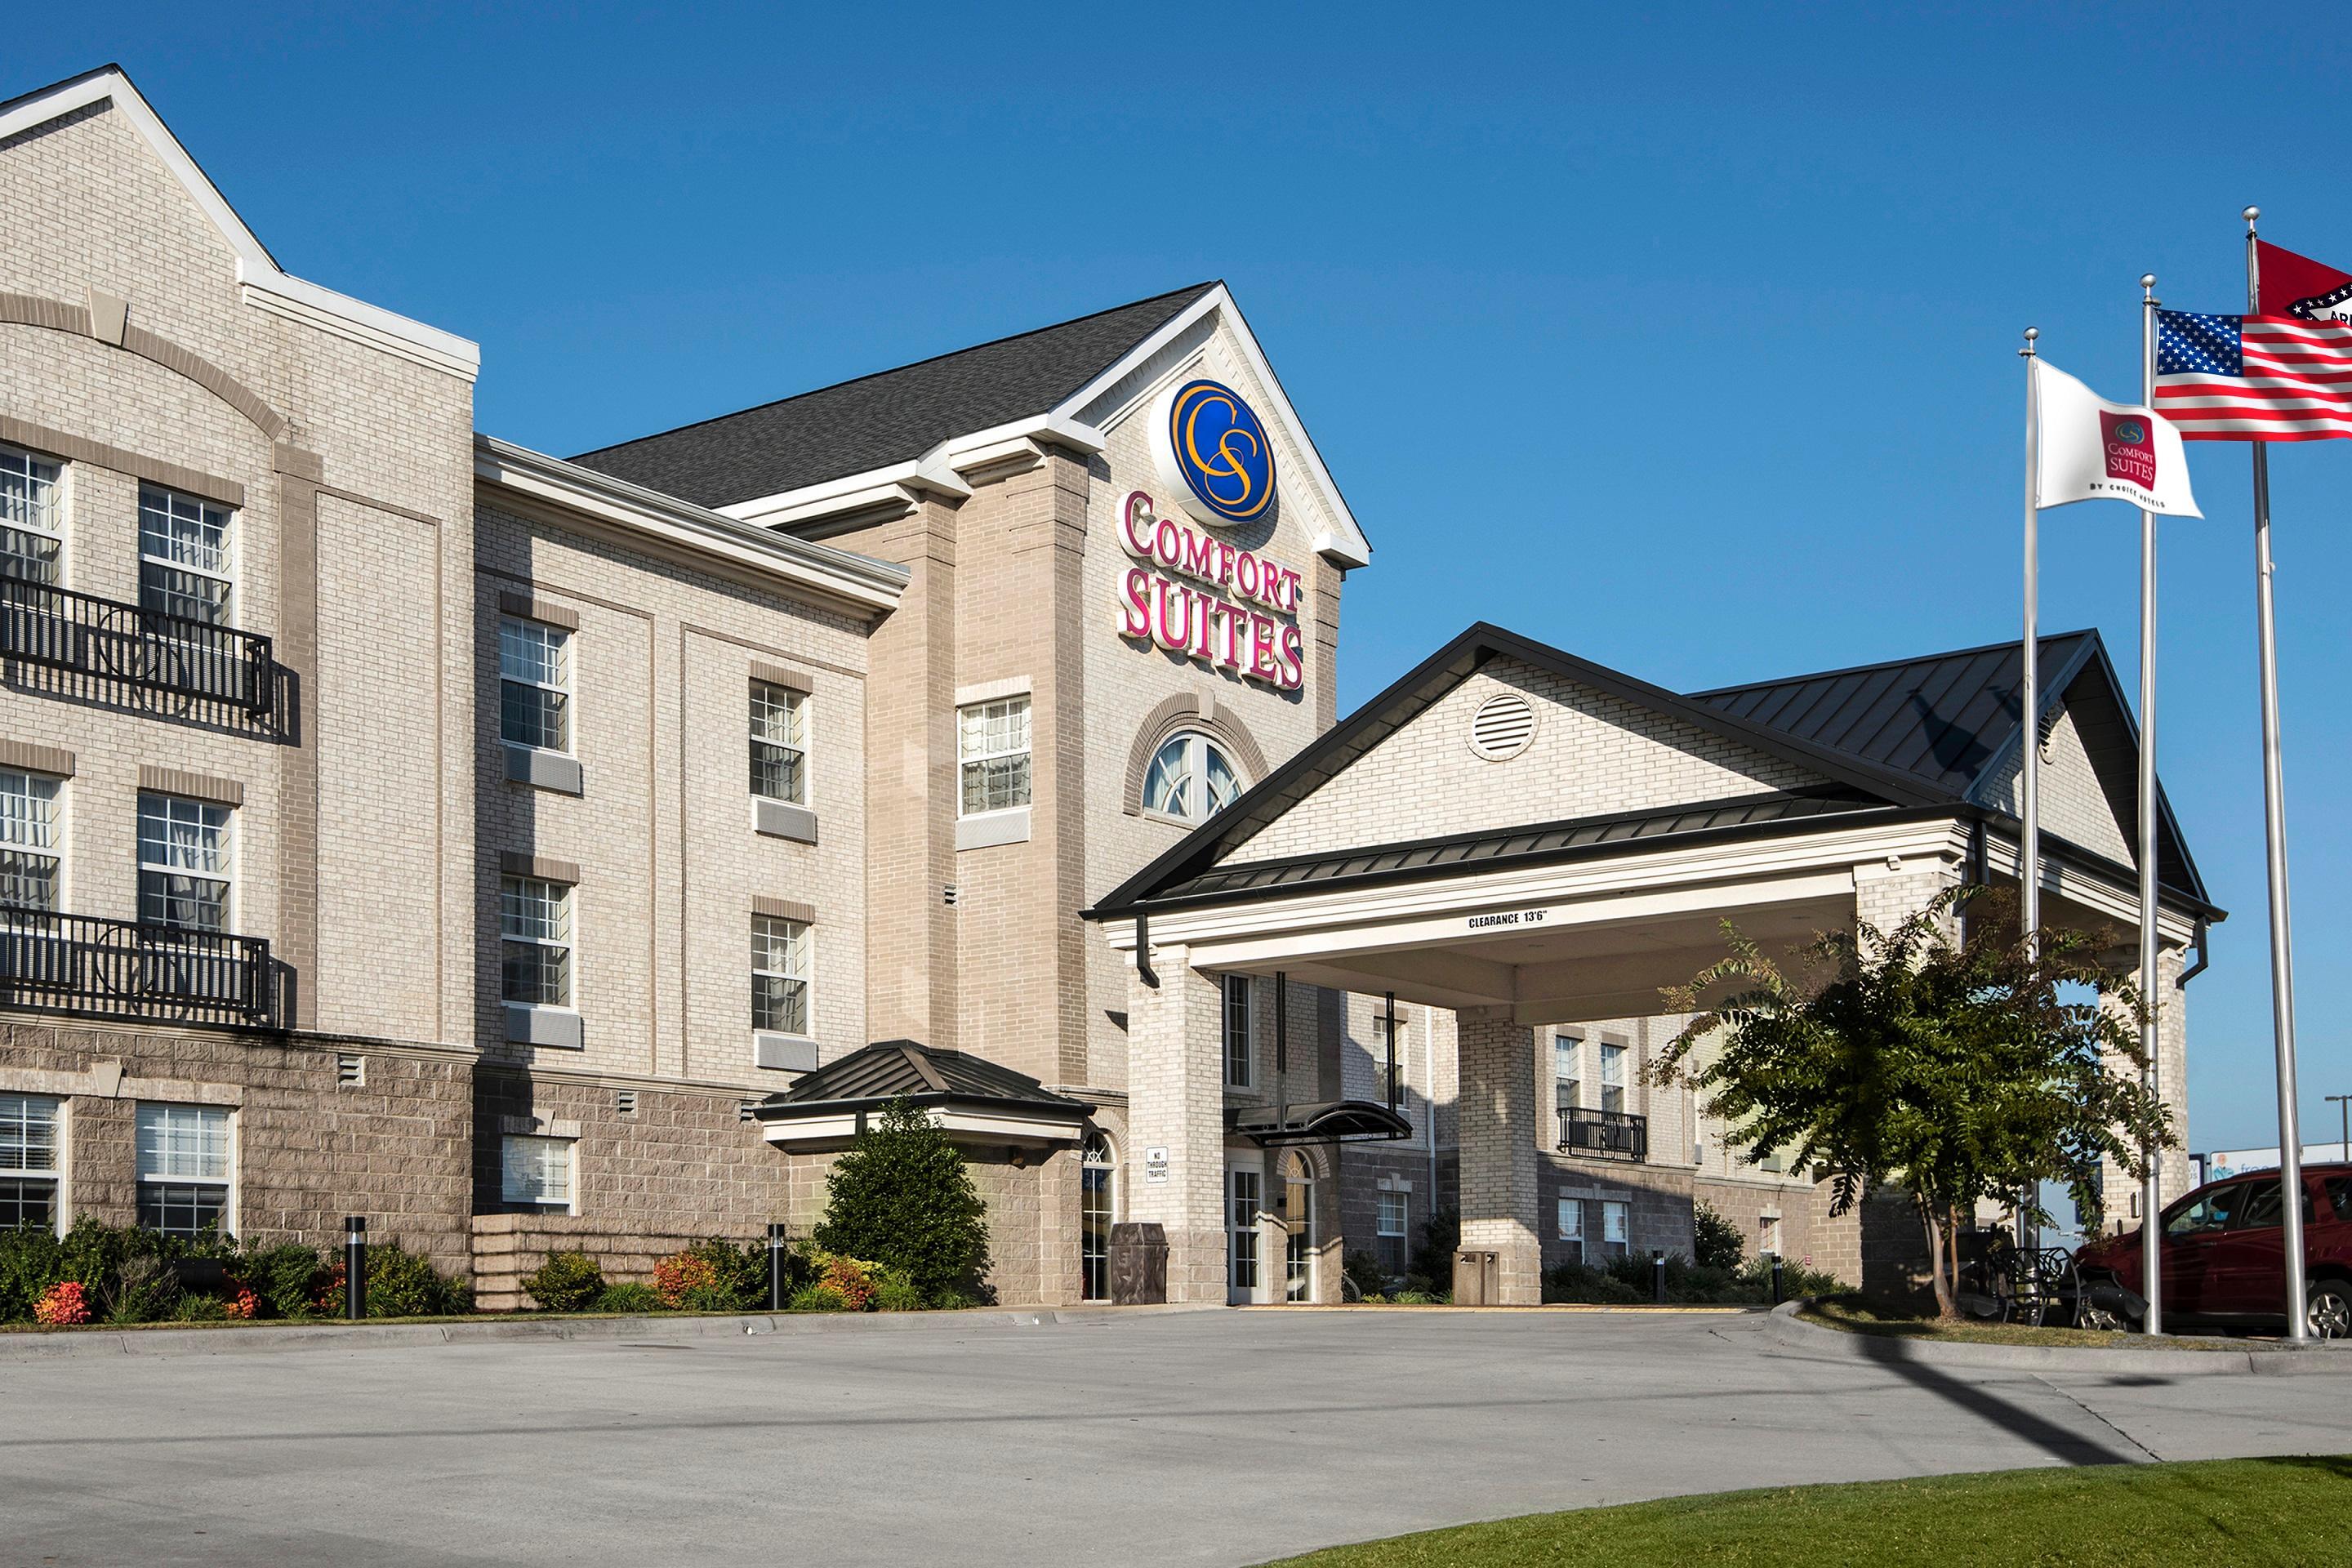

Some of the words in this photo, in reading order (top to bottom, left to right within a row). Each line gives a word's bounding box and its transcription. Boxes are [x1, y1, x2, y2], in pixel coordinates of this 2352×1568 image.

[2108, 443, 2154, 464] COMFORT
[2110, 457, 2154, 481] SUITES
[2109, 484, 2137, 497] CHOICE
[1124, 490, 1302, 613] COMFORT
[1125, 568, 1303, 689] SUITES
[1468, 913, 1519, 929] CLEARANCE
[1153, 1152, 1160, 1160] NO
[1148, 1169, 1166, 1178] TRAFFIC
